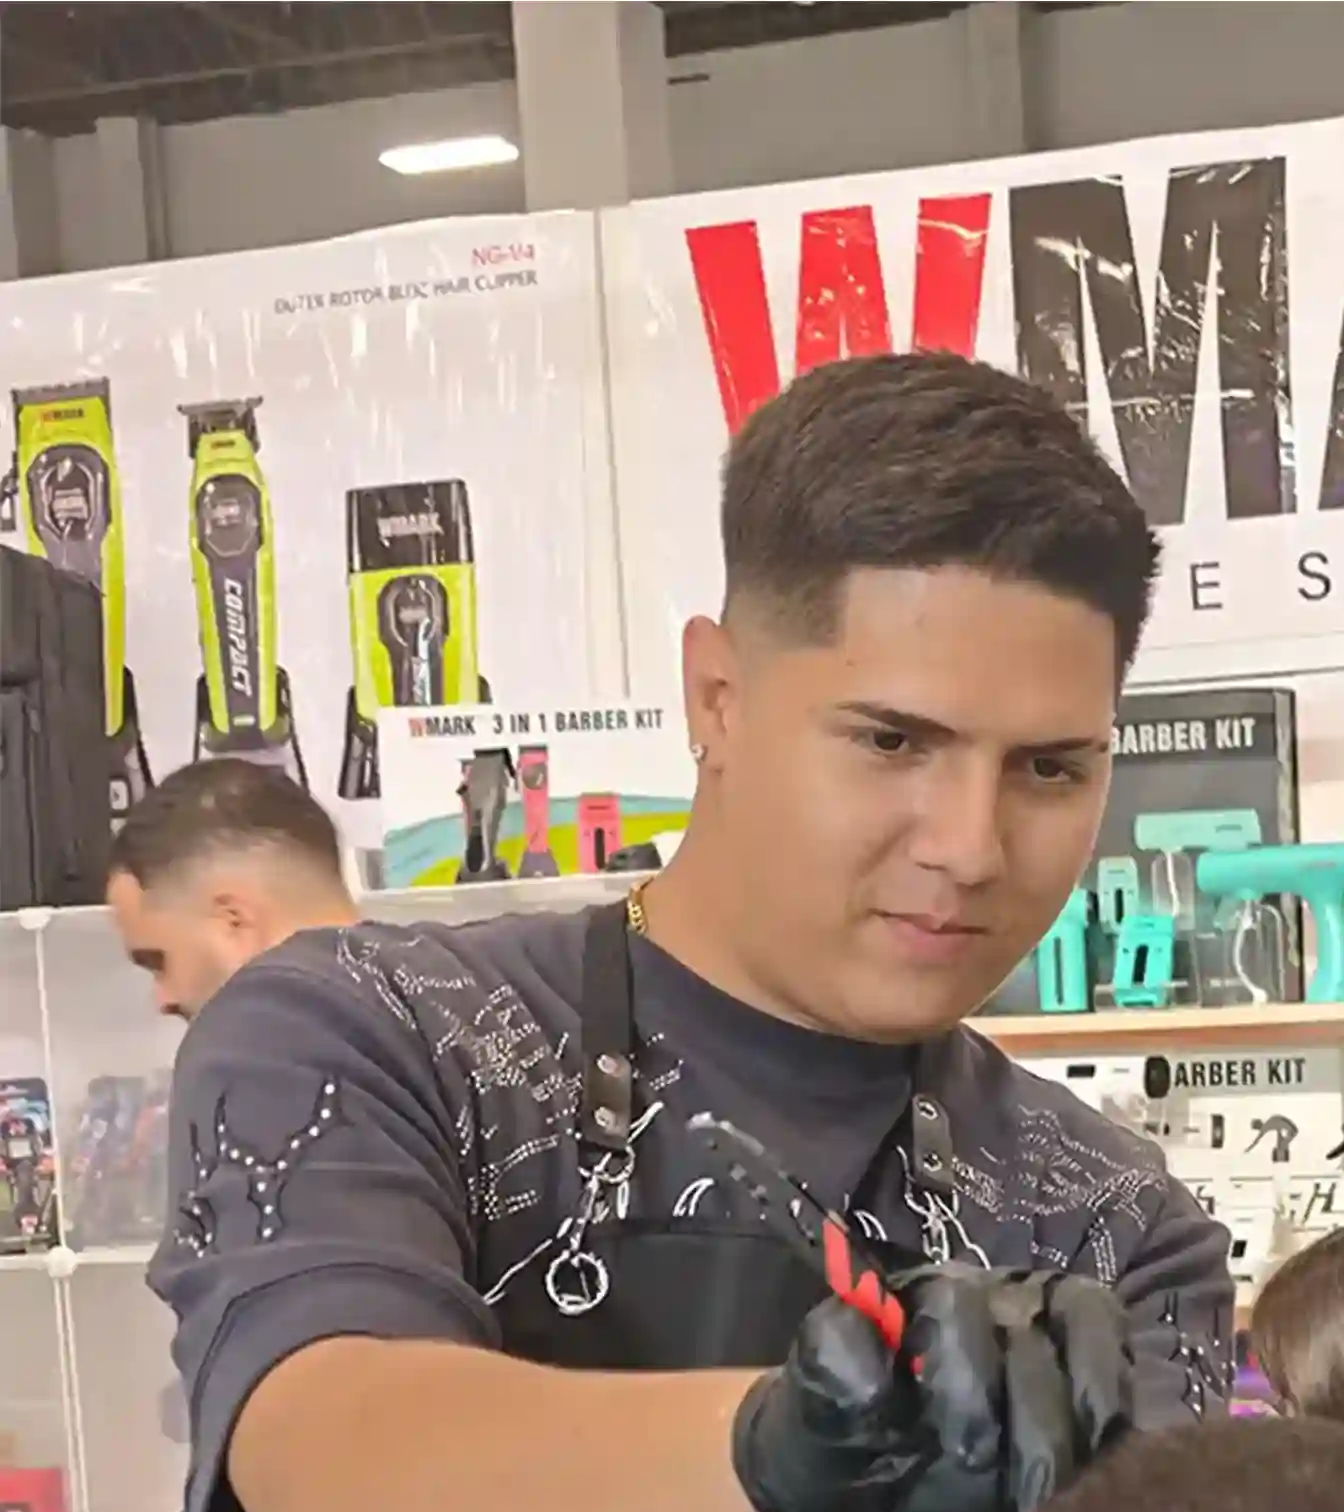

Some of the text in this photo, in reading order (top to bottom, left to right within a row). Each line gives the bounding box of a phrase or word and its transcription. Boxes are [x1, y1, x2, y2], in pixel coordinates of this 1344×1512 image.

[408, 709, 664, 737] WMARK 3 IN 1 BARBER KIT
[1216, 717, 1255, 749] KIT
[1174, 1058, 1305, 1087] ARBER KIT
